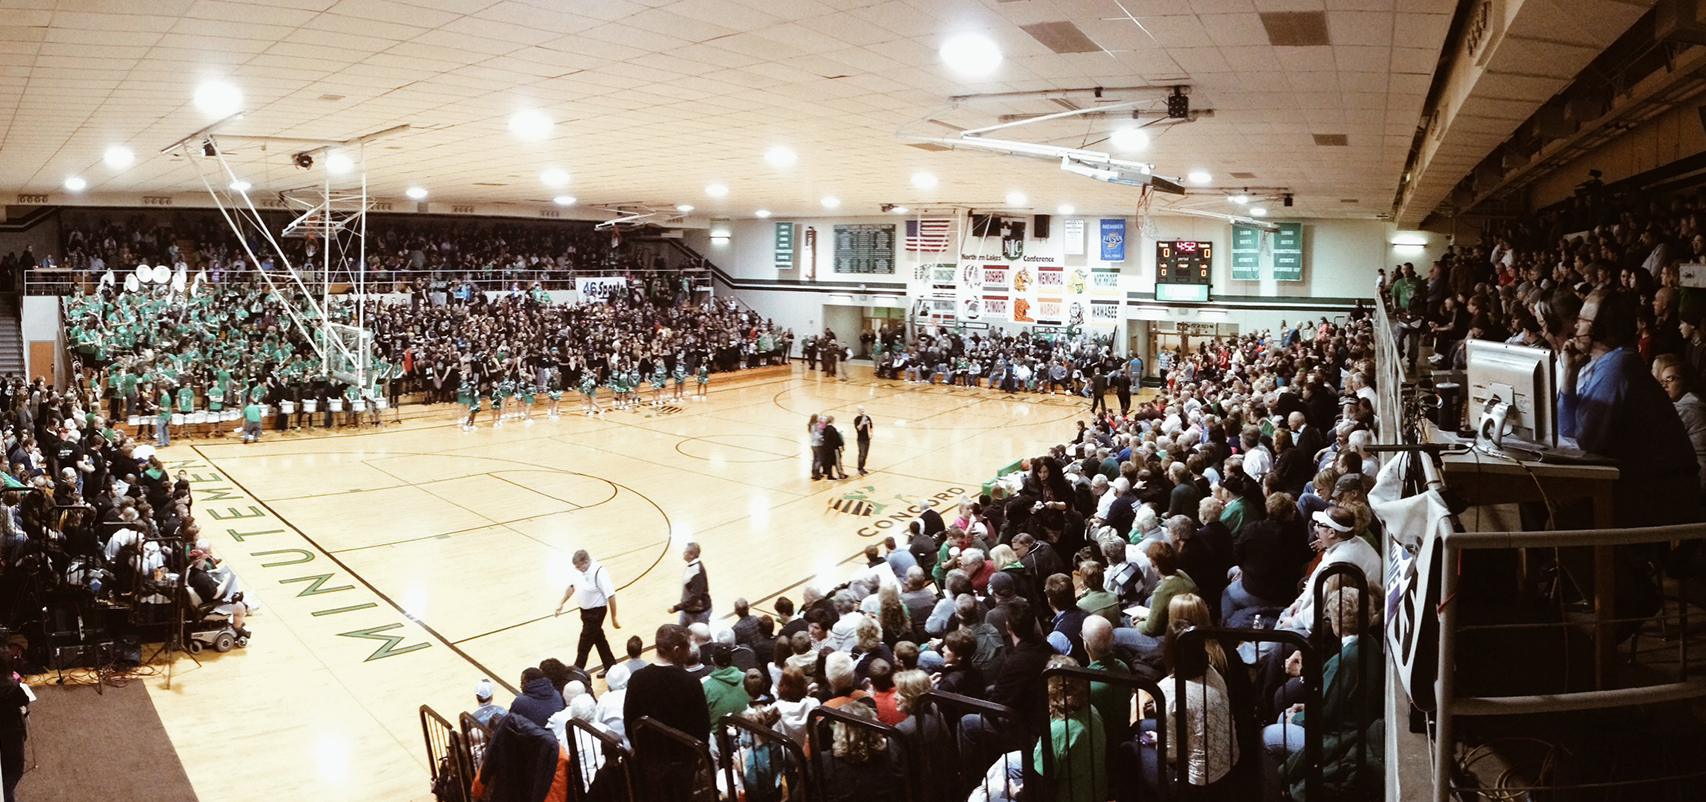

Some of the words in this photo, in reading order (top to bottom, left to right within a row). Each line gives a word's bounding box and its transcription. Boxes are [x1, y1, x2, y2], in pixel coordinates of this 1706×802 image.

[1004, 239, 1022, 258] NLC
[1163, 248, 1170, 258] 0
[1176, 242, 1196, 252] 4:52
[1204, 248, 1211, 259] 0
[986, 254, 1002, 262] Lakes
[1023, 255, 1055, 263] Conference
[984, 270, 1006, 283] GOSHEN
[1037, 272, 1064, 285] MEMORIAL
[583, 281, 597, 294] 46
[984, 300, 1007, 314] PLYMOUTH
[1040, 303, 1061, 316] WARSAW
[1091, 305, 1118, 319] WAWASEE
[162, 458, 433, 663] MINUTEMEN
